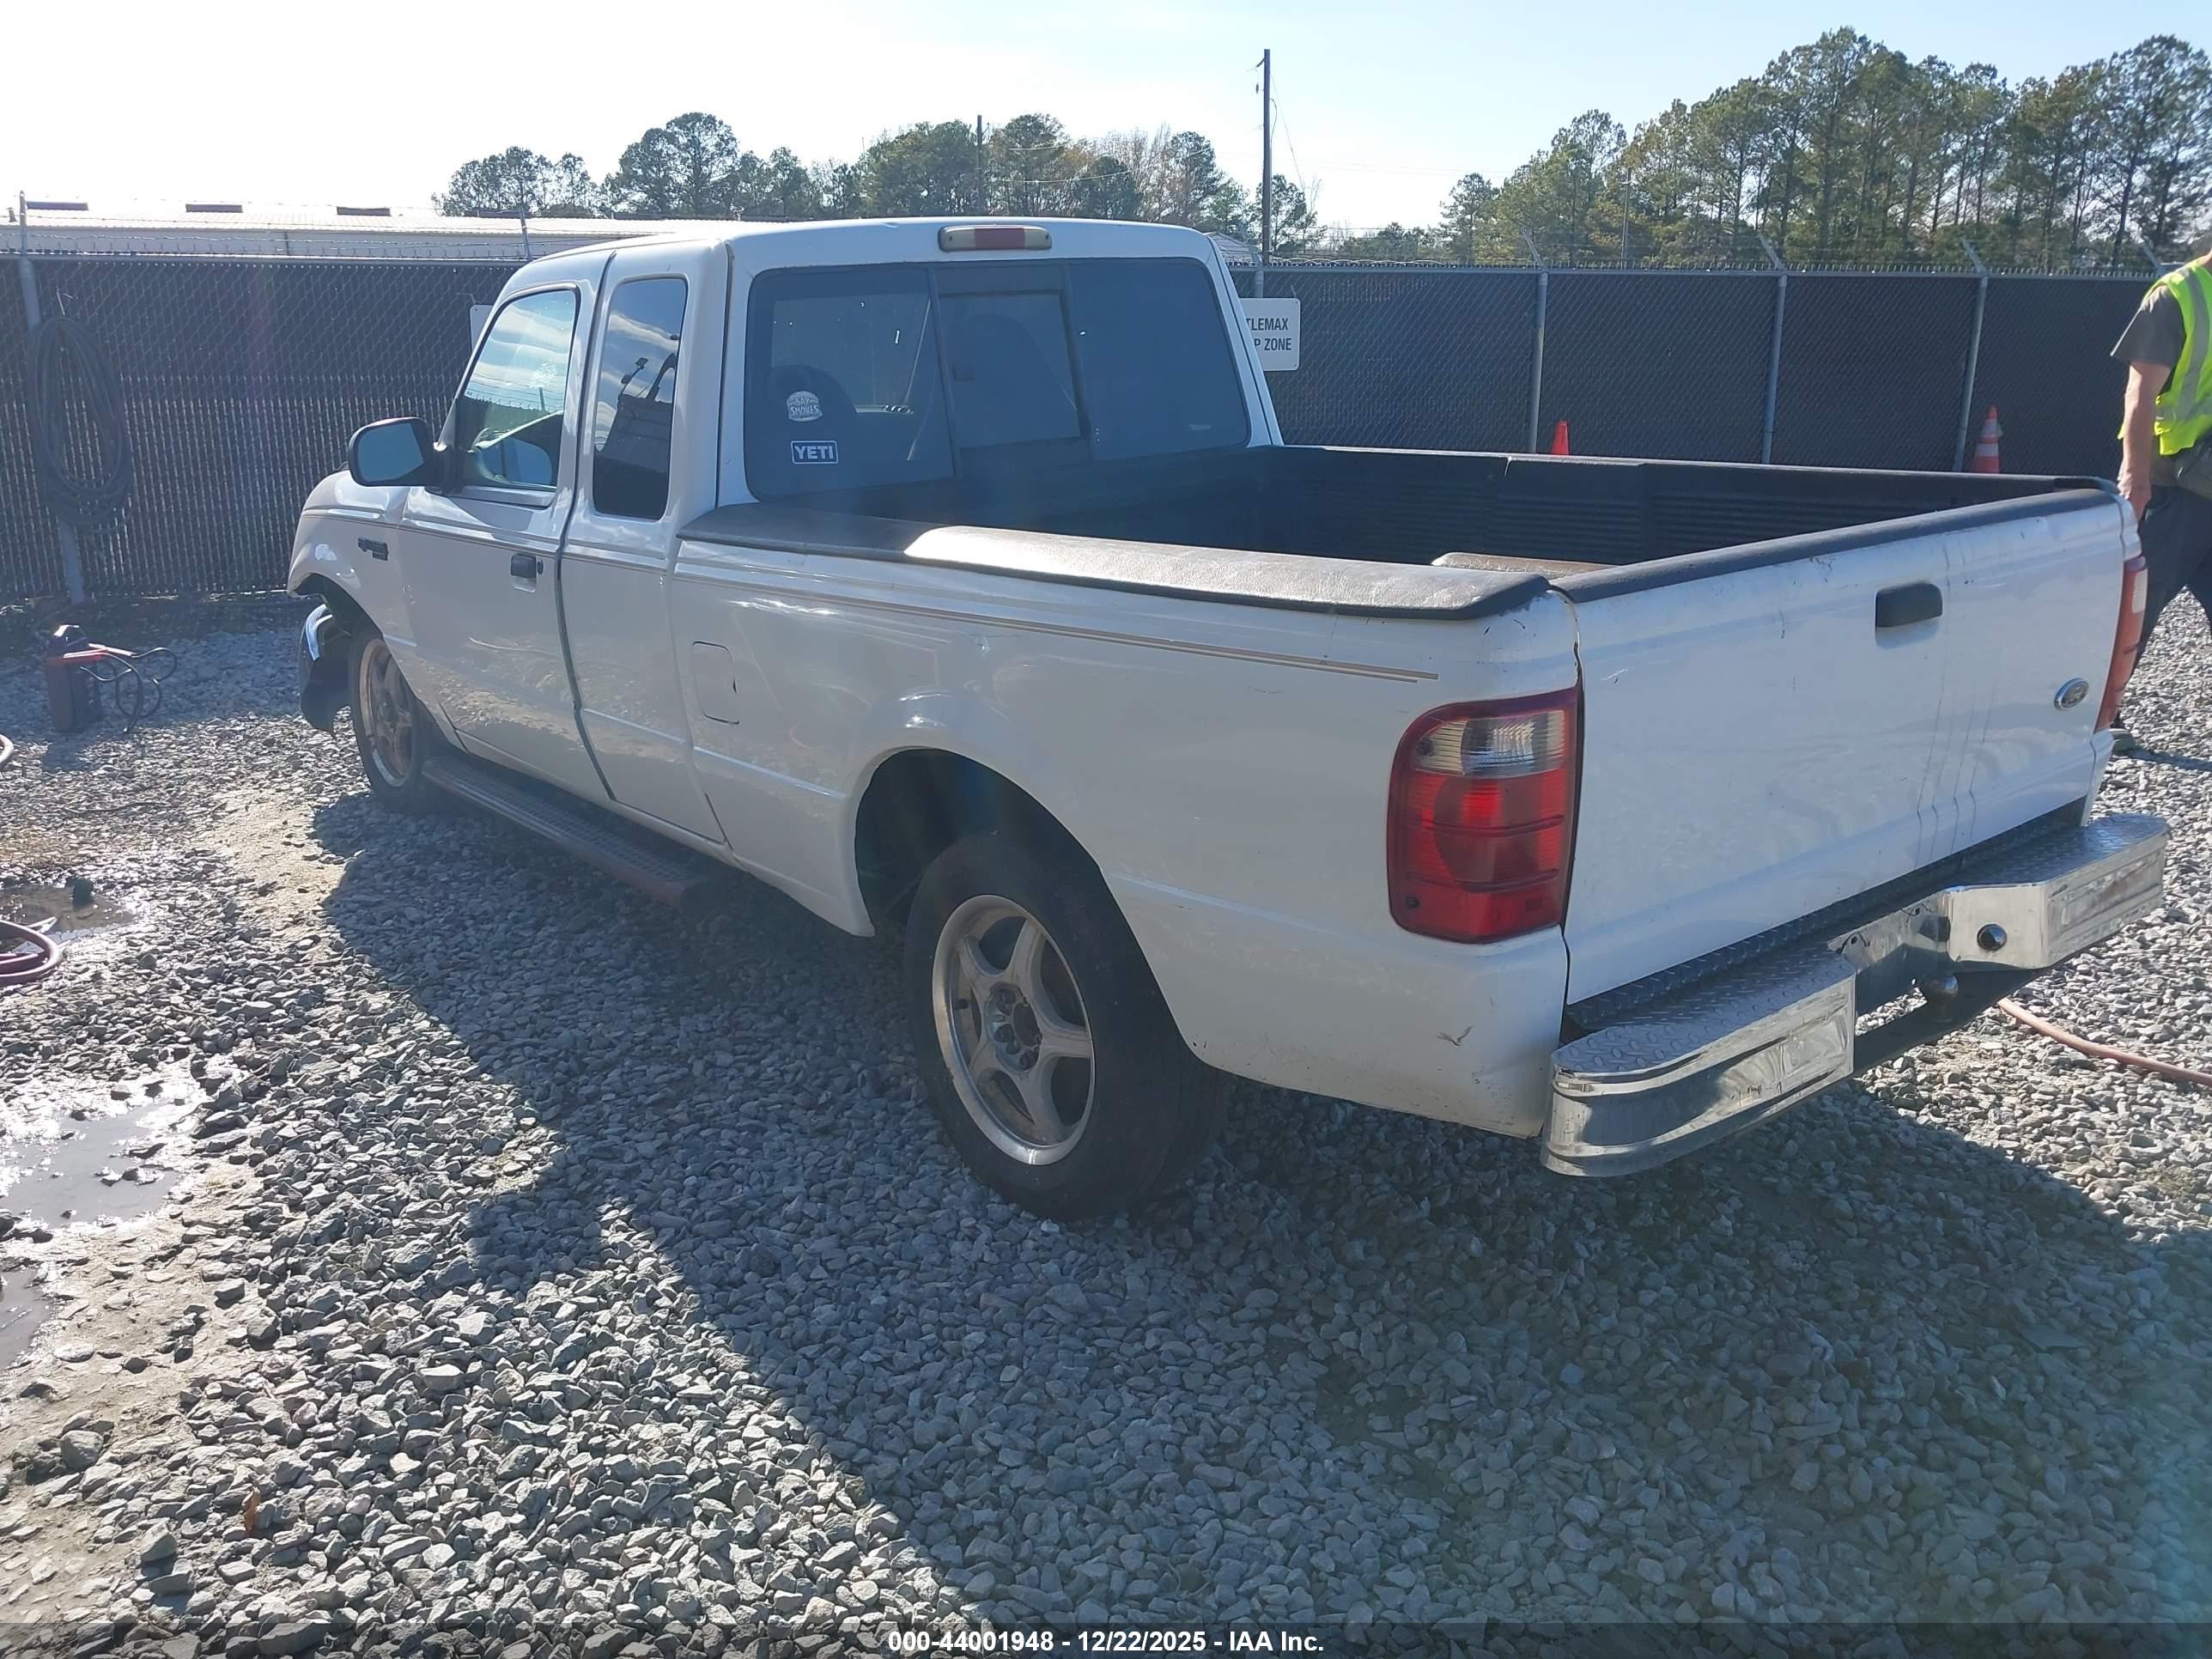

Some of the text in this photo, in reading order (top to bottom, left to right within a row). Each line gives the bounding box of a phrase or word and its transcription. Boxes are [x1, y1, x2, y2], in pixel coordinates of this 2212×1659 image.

[1246, 318, 1289, 331] TLEMAX
[1264, 337, 1292, 351] ZONE
[794, 446, 835, 459] YETI
